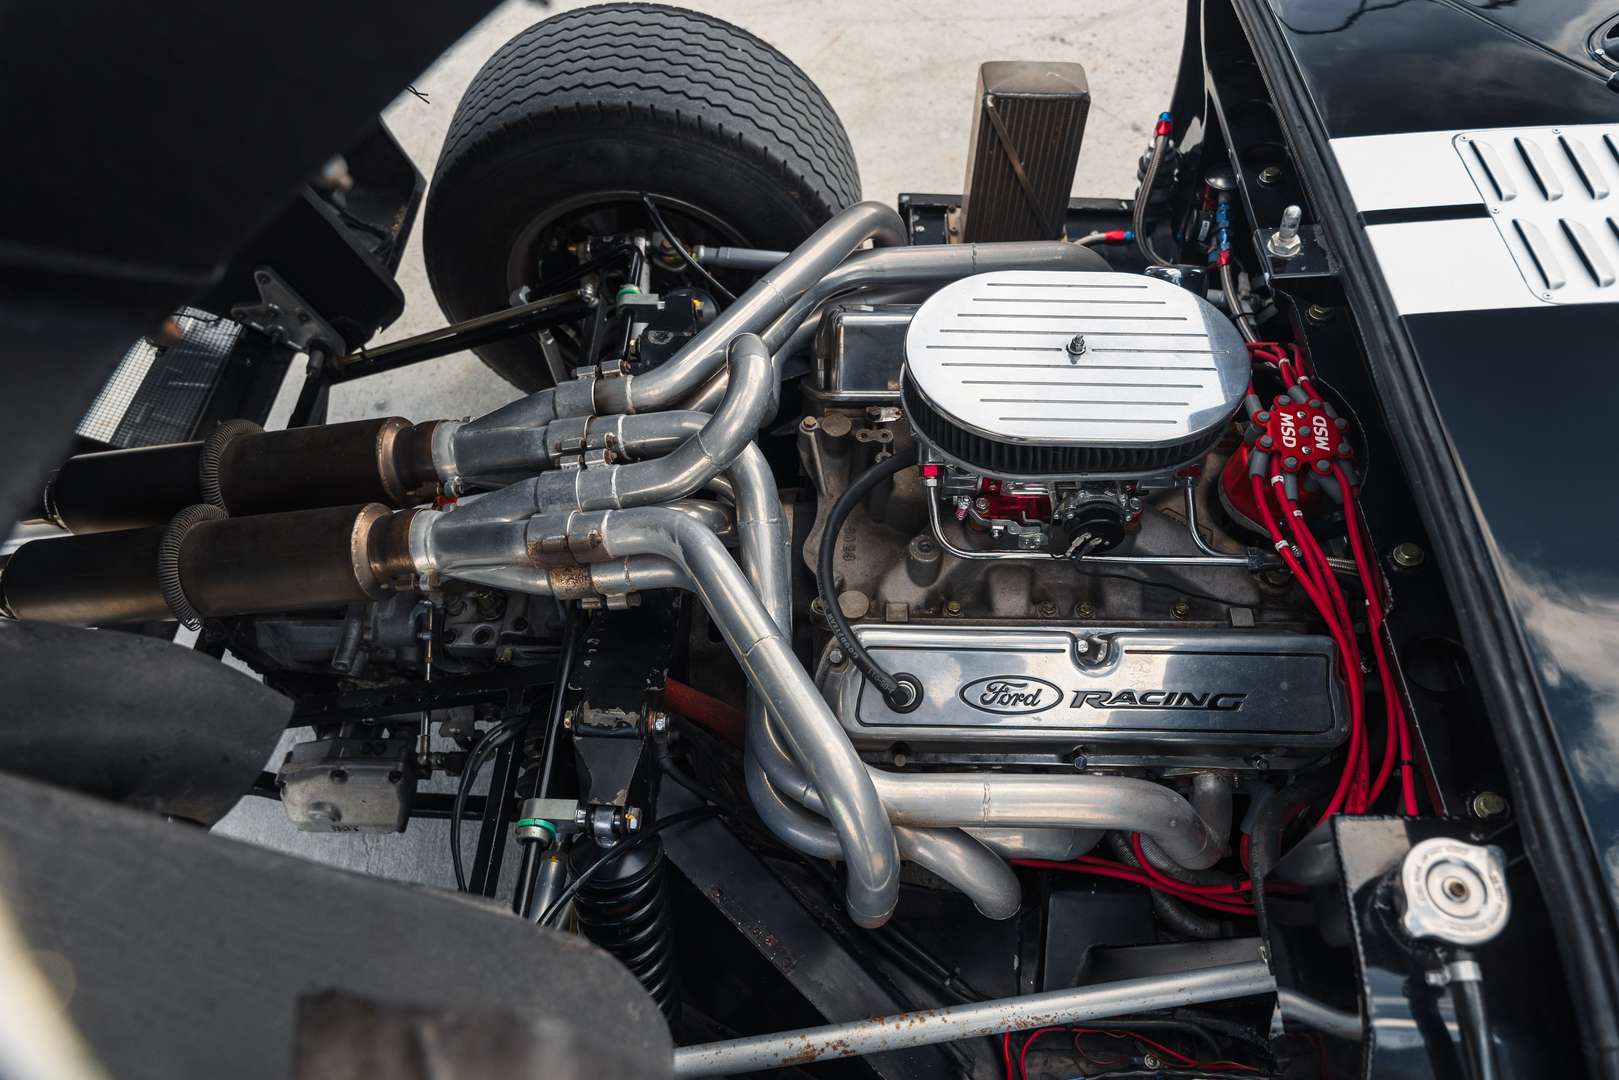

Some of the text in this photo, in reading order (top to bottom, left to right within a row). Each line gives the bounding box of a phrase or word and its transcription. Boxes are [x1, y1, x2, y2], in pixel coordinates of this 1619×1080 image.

[1280, 412, 1297, 448] MSD
[1312, 415, 1331, 451] MSD
[828, 611, 859, 660] GOODYEAR
[979, 681, 1249, 712] Ford RACING
